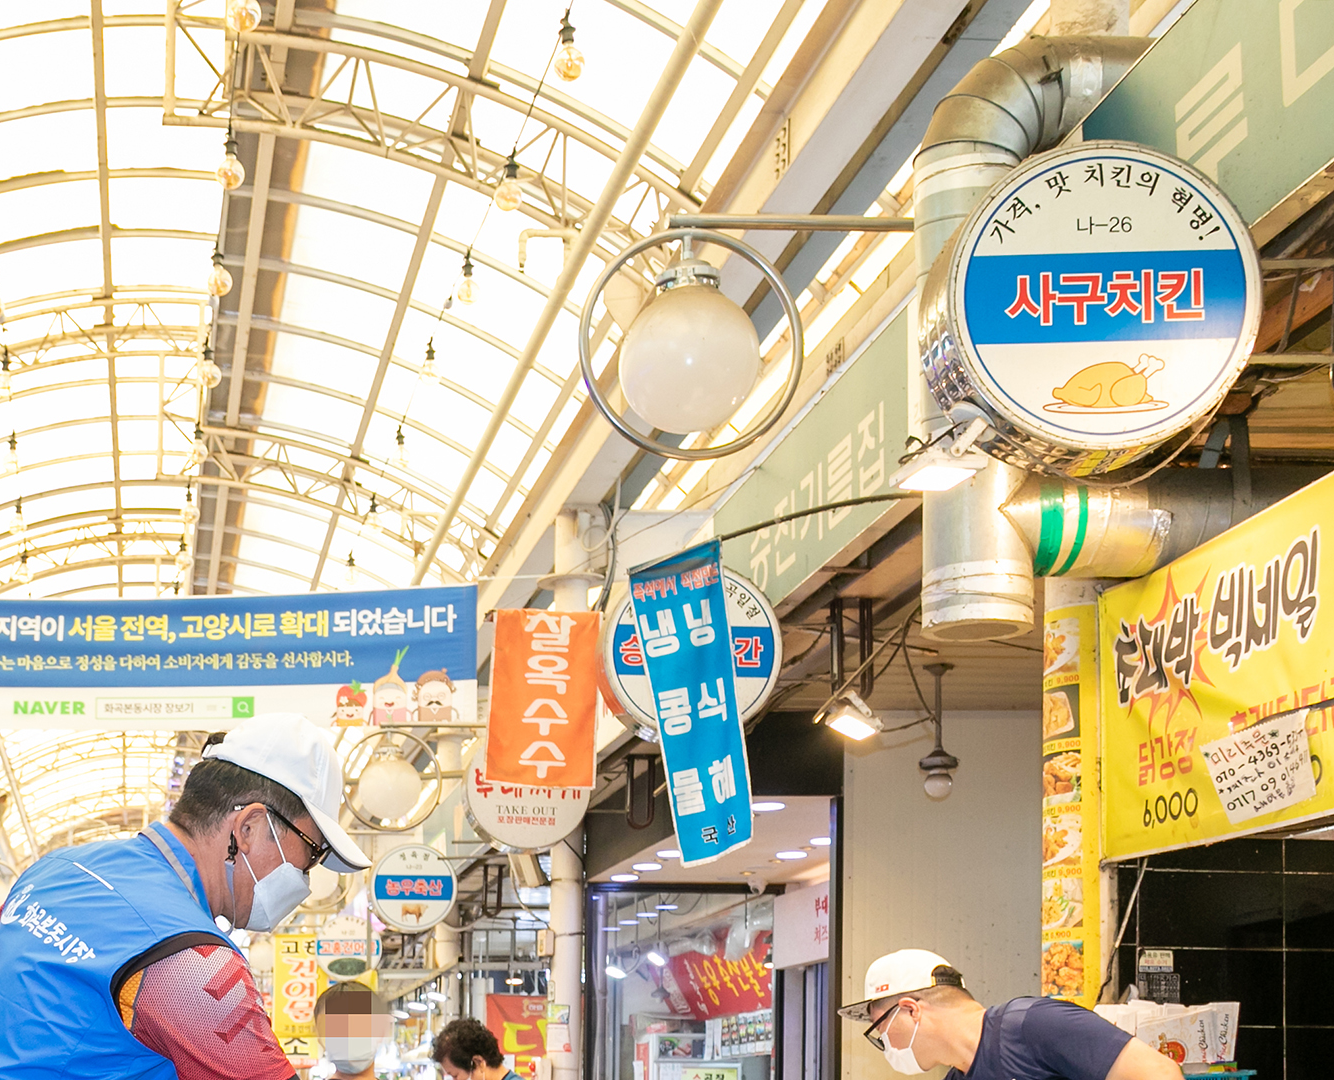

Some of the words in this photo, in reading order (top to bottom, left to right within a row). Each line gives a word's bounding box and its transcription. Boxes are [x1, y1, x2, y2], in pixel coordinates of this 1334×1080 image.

[990, 197, 1041, 244] 가격,
[1044, 171, 1072, 199] 맛
[1083, 163, 1161, 197] 치킨의
[1171, 187, 1221, 242] 혁명!
[1004, 268, 1206, 326] 사구치킨
[633, 576, 678, 602] 즉석에서
[1207, 524, 1321, 673] 빅세일
[68, 614, 118, 642] 서울
[120, 613, 177, 644] 전역,
[179, 612, 278, 640] 고양시로
[279, 610, 329, 638] 확대
[332, 604, 457, 637] 되었습니다
[17, 655, 73, 671] 마음으로
[75, 655, 117, 672] 정성을
[119, 654, 161, 671] 다하여
[163, 652, 234, 670] 소비자에게
[236, 651, 279, 669] 감동을
[281, 650, 355, 668] 선사합시다.
[13, 700, 86, 715] NAVER
[104, 702, 163, 714] 화곡본동시장
[165, 702, 195, 714] 장보기
[519, 613, 577, 779] 찰옥수수
[1138, 727, 1199, 787] 닭강정
[496, 805, 528, 815] TAKE
[533, 805, 558, 816] OUT
[497, 815, 556, 826] 포장판매전문점
[1143, 787, 1199, 829] 6,000
[385, 878, 443, 897] 농우축산
[17, 901, 97, 964] 화곡본동시장
